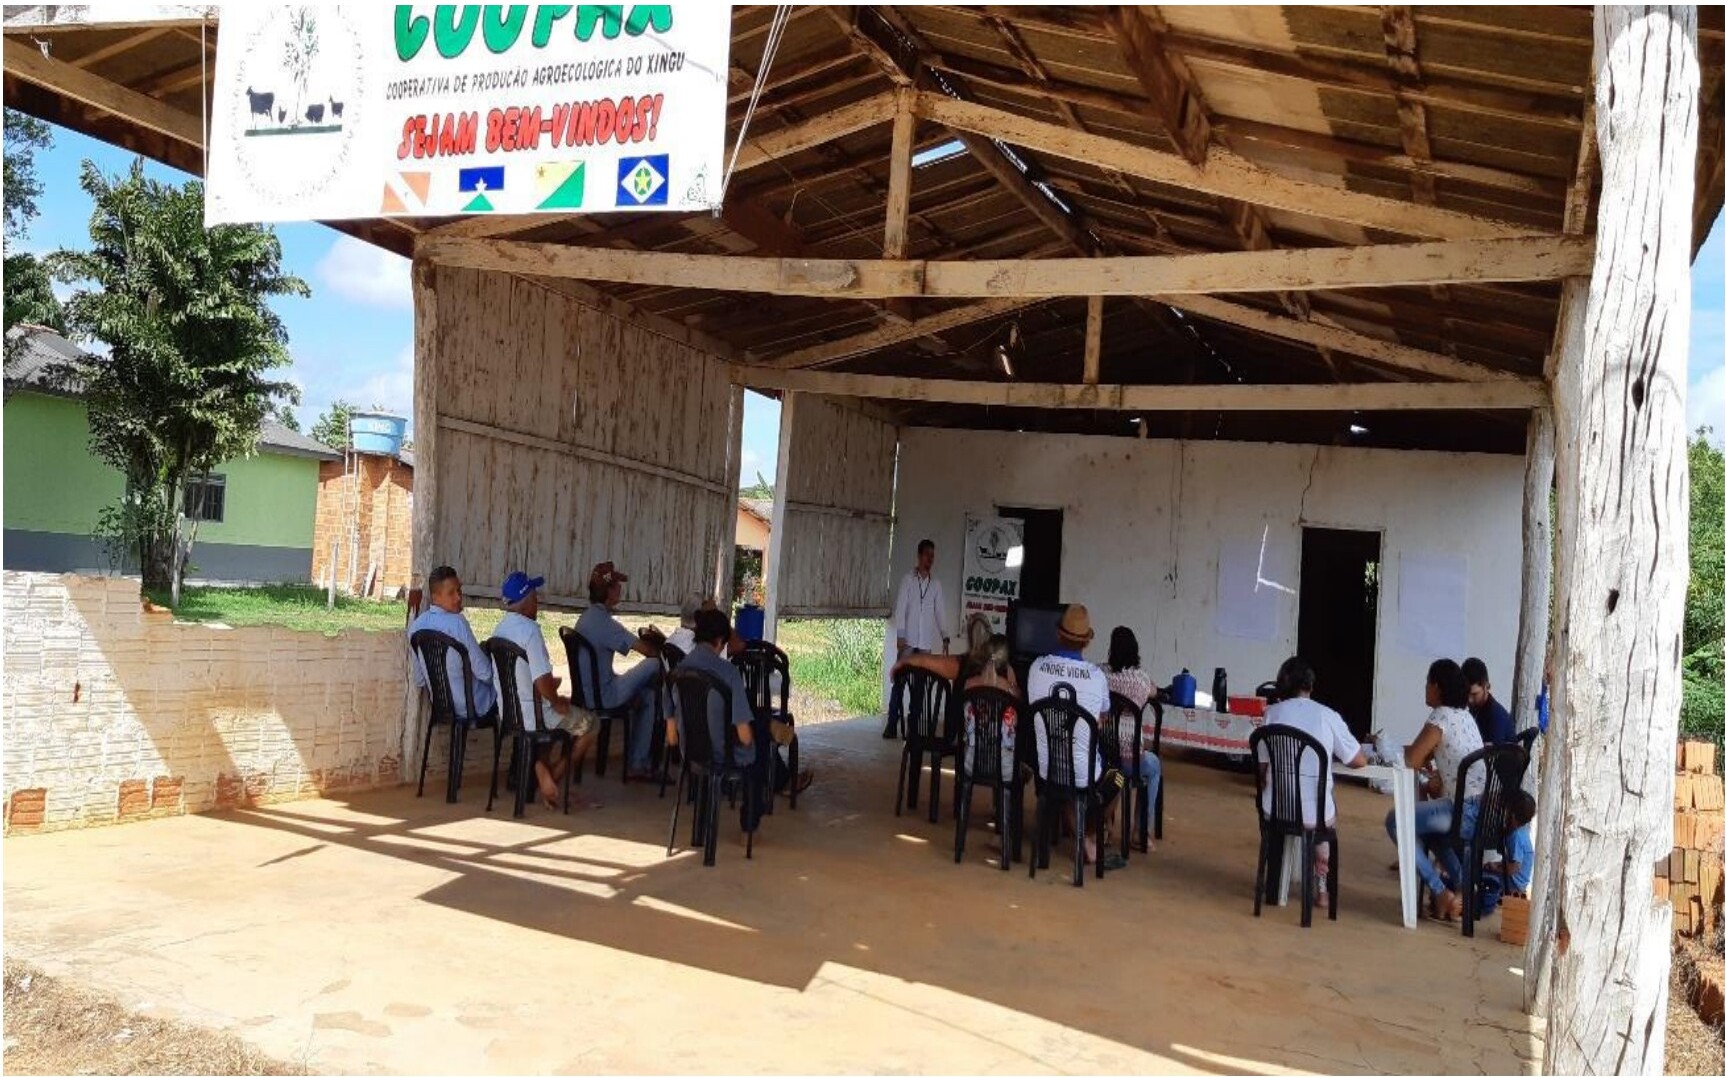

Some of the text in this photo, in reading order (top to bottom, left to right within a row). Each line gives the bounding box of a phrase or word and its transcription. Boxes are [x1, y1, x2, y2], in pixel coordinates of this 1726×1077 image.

[386, 76, 450, 100] COOPERATIVA
[453, 74, 468, 93] DE
[626, 55, 643, 75] DO
[646, 51, 685, 74] XINGU
[397, 93, 664, 160] SEJAM BEM-VINDOS!
